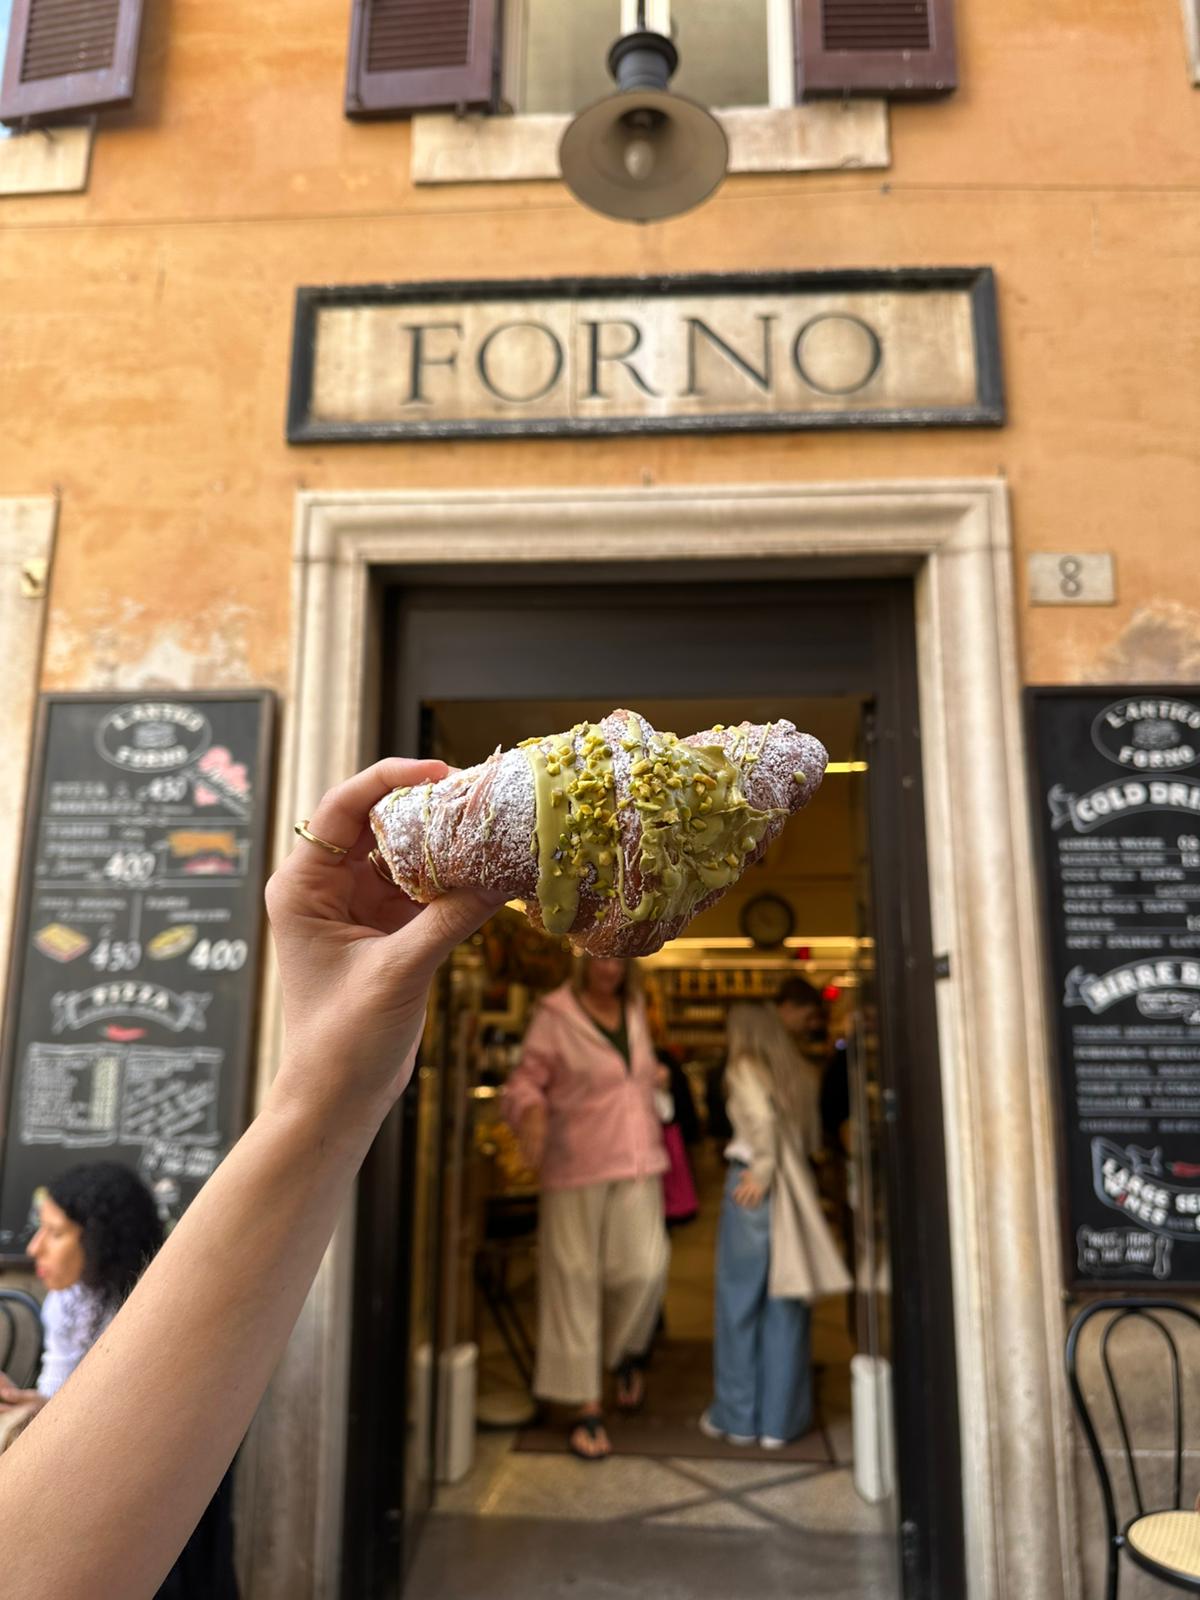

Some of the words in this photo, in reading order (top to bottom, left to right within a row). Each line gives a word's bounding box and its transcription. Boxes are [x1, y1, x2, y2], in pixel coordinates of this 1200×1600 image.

[403, 311, 884, 405] FORNO
[1058, 555, 1084, 598] 8
[1118, 745, 1195, 768] FORNO
[1076, 782, 1148, 821] COLD
